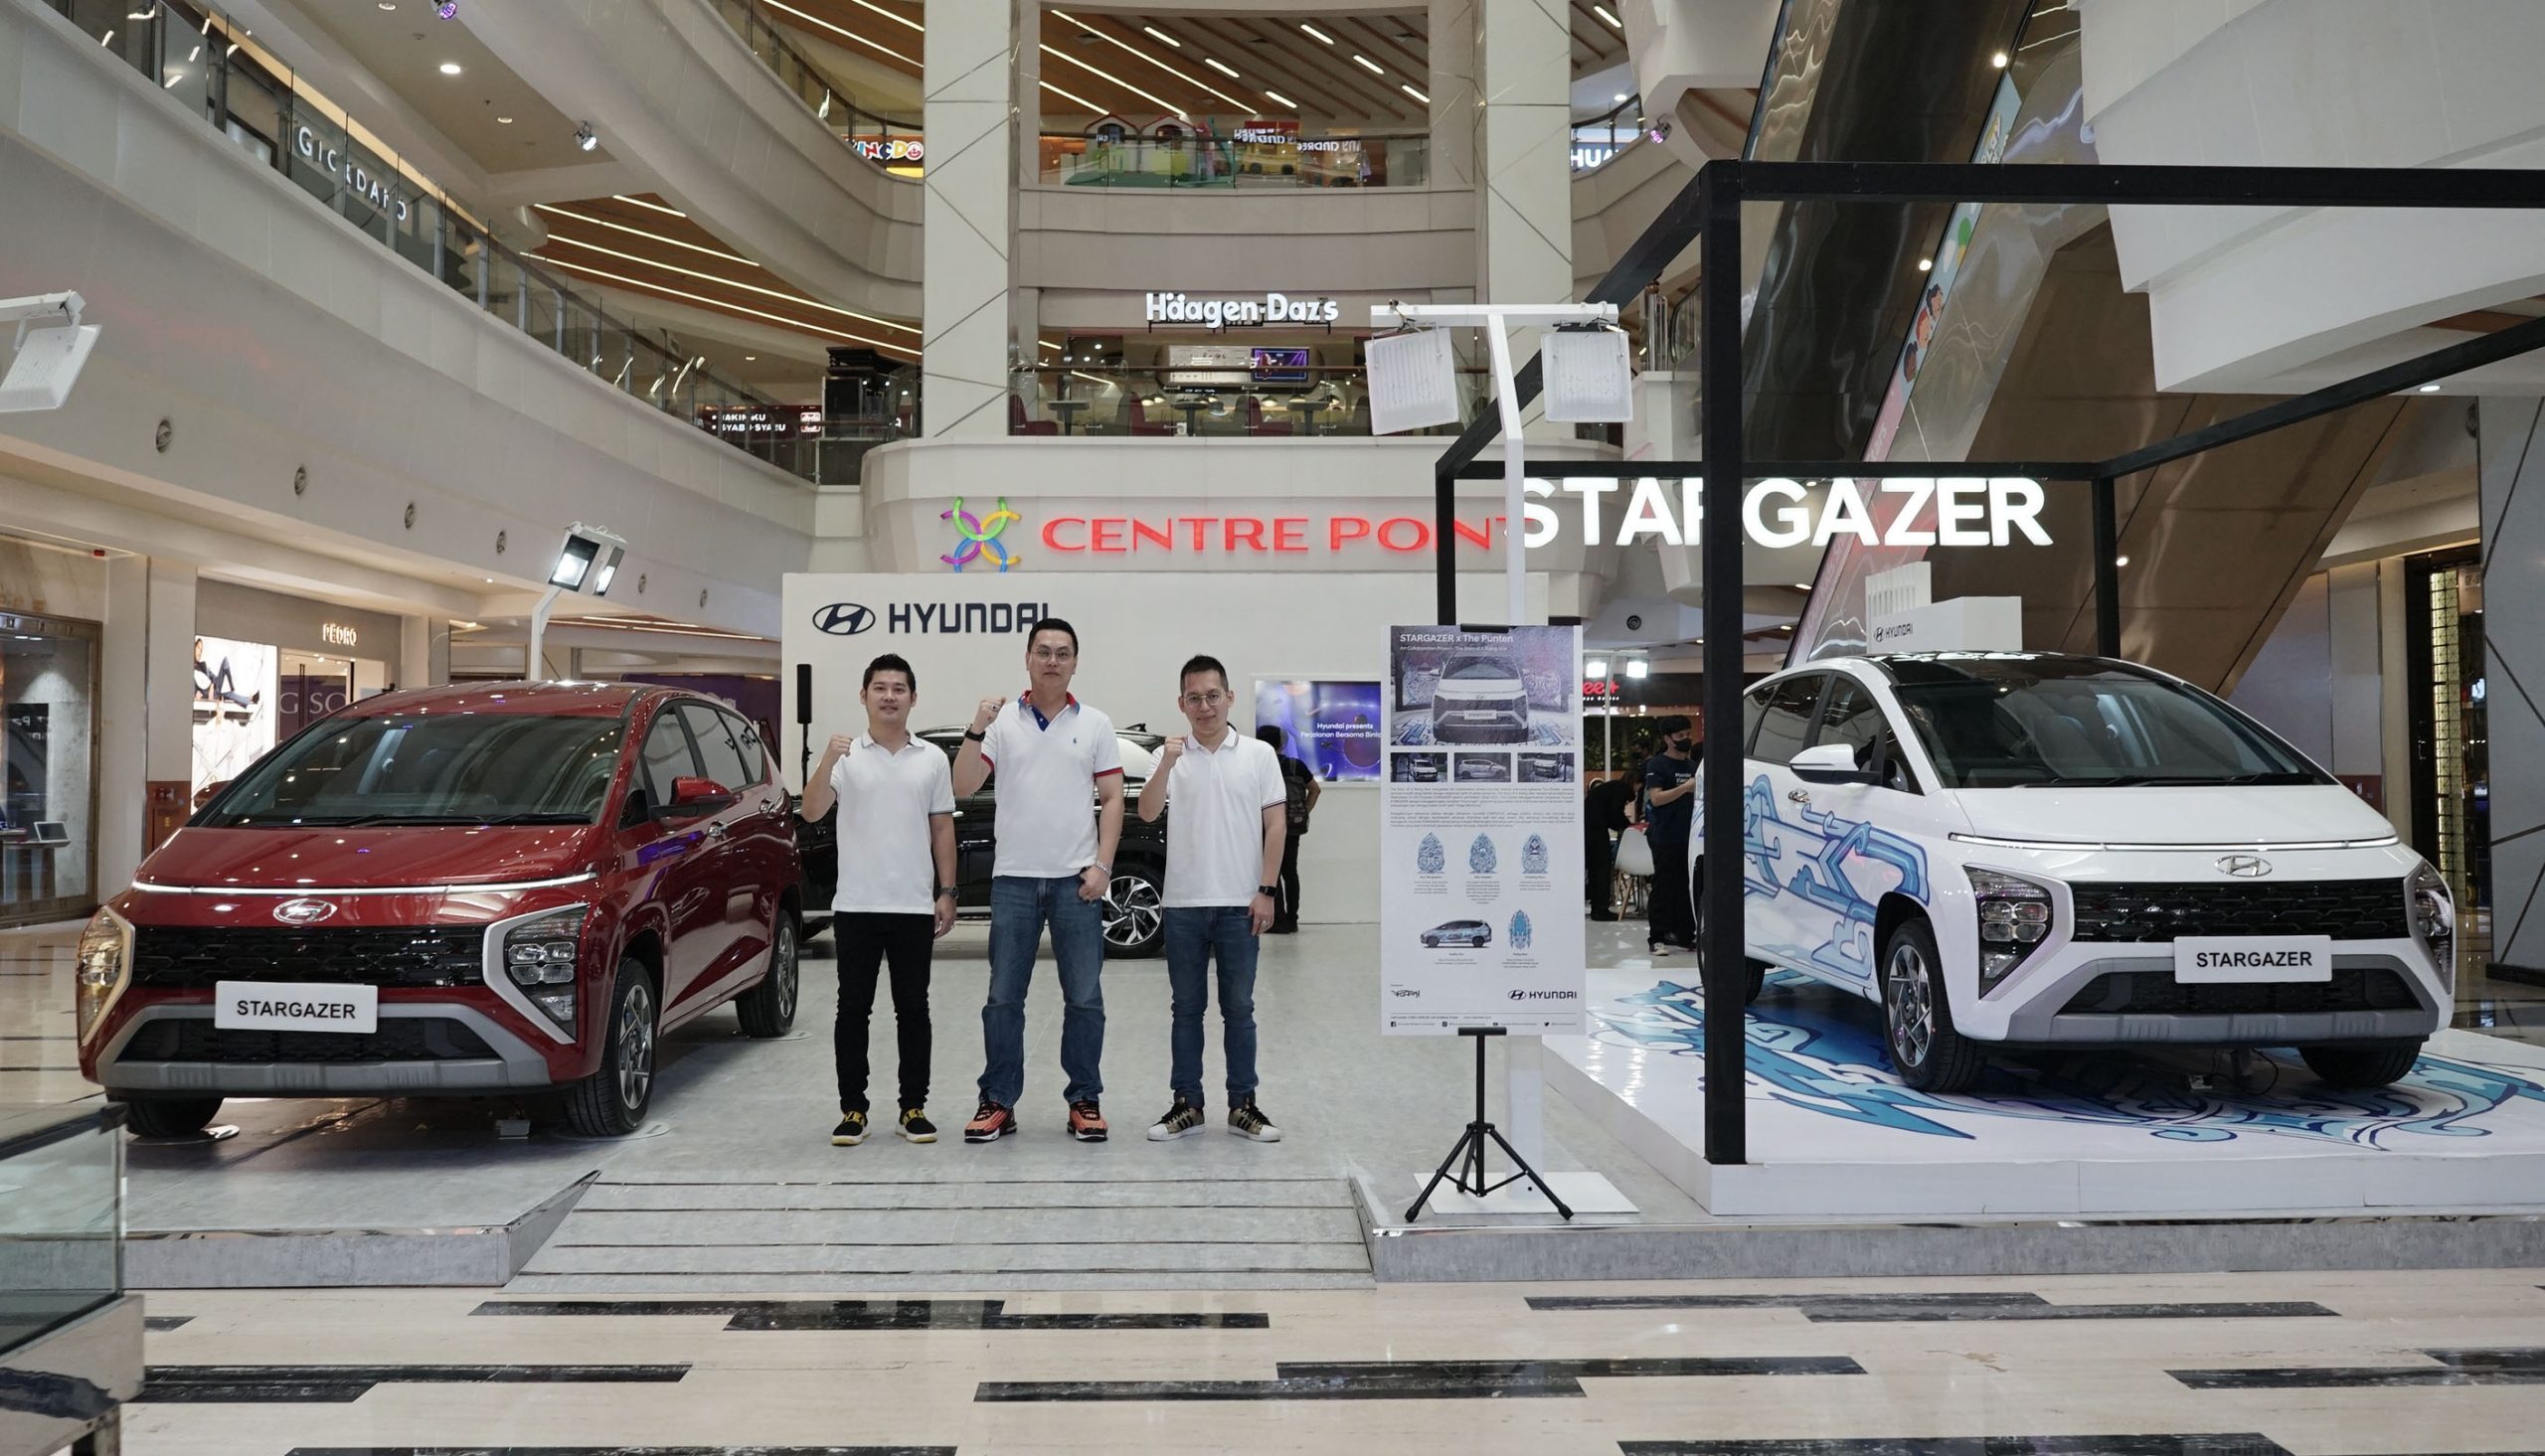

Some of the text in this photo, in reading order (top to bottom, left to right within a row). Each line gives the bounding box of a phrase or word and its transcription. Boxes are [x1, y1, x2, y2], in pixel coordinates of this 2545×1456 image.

[1042, 517, 1537, 552] CENTRE PON
[322, 623, 358, 646] PEDRO
[1400, 634, 1454, 643] STARGAZER
[1463, 634, 1480, 643] The
[1481, 634, 1514, 643] Punten
[1885, 623, 1914, 639] HYUNDAI
[2196, 951, 2312, 968] STARGAZER
[1529, 991, 1578, 1000] HYUNDAI
[237, 1000, 356, 1020] STARGAZER
